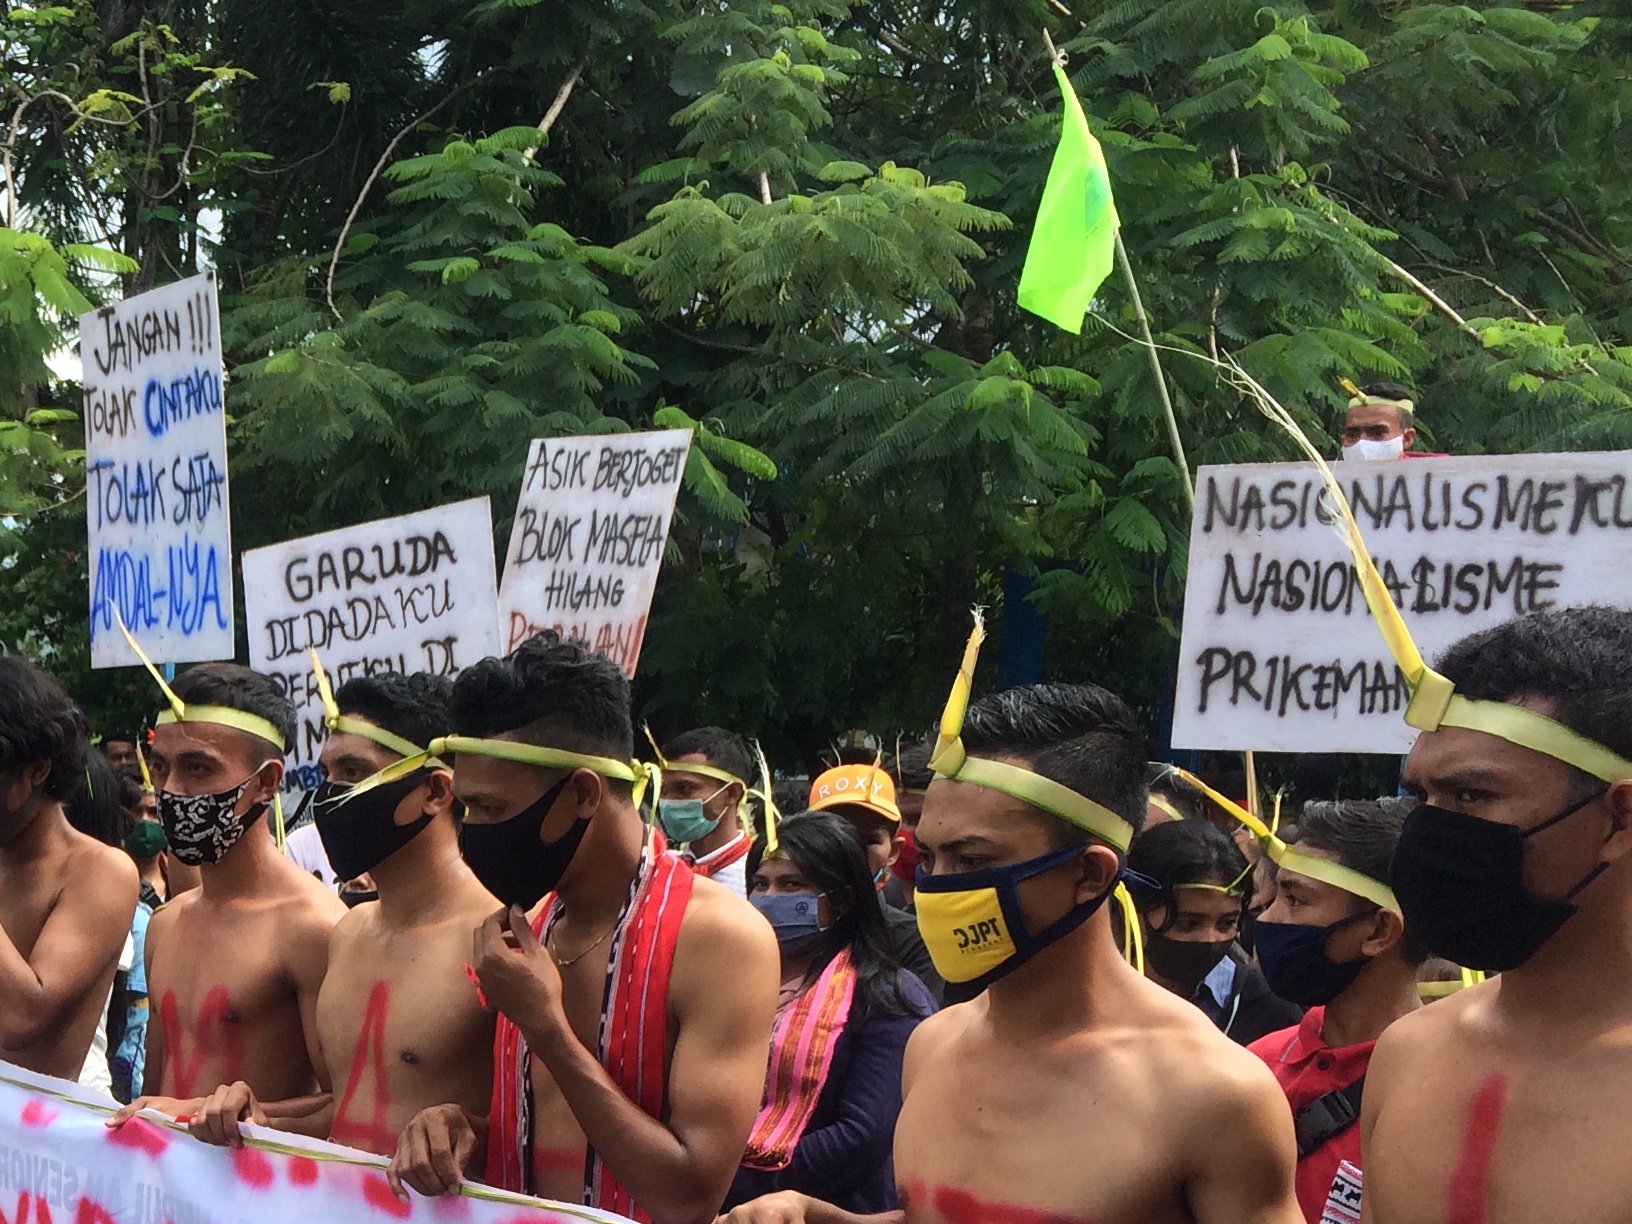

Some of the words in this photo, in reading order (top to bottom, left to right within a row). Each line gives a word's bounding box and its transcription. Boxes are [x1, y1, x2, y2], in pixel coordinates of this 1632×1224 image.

[93, 307, 181, 376] JANGAN
[83, 384, 137, 443] TOLAK
[87, 458, 166, 532] TOLAK
[526, 440, 592, 493] ASIK
[592, 445, 687, 499] BERJOGET
[284, 530, 458, 602] GARUDA
[513, 505, 582, 570] BLOK
[264, 578, 455, 662] DIDADAKU
[545, 568, 626, 614] HILANG
[420, 635, 460, 677] DI
[818, 776, 884, 800] ROXY
